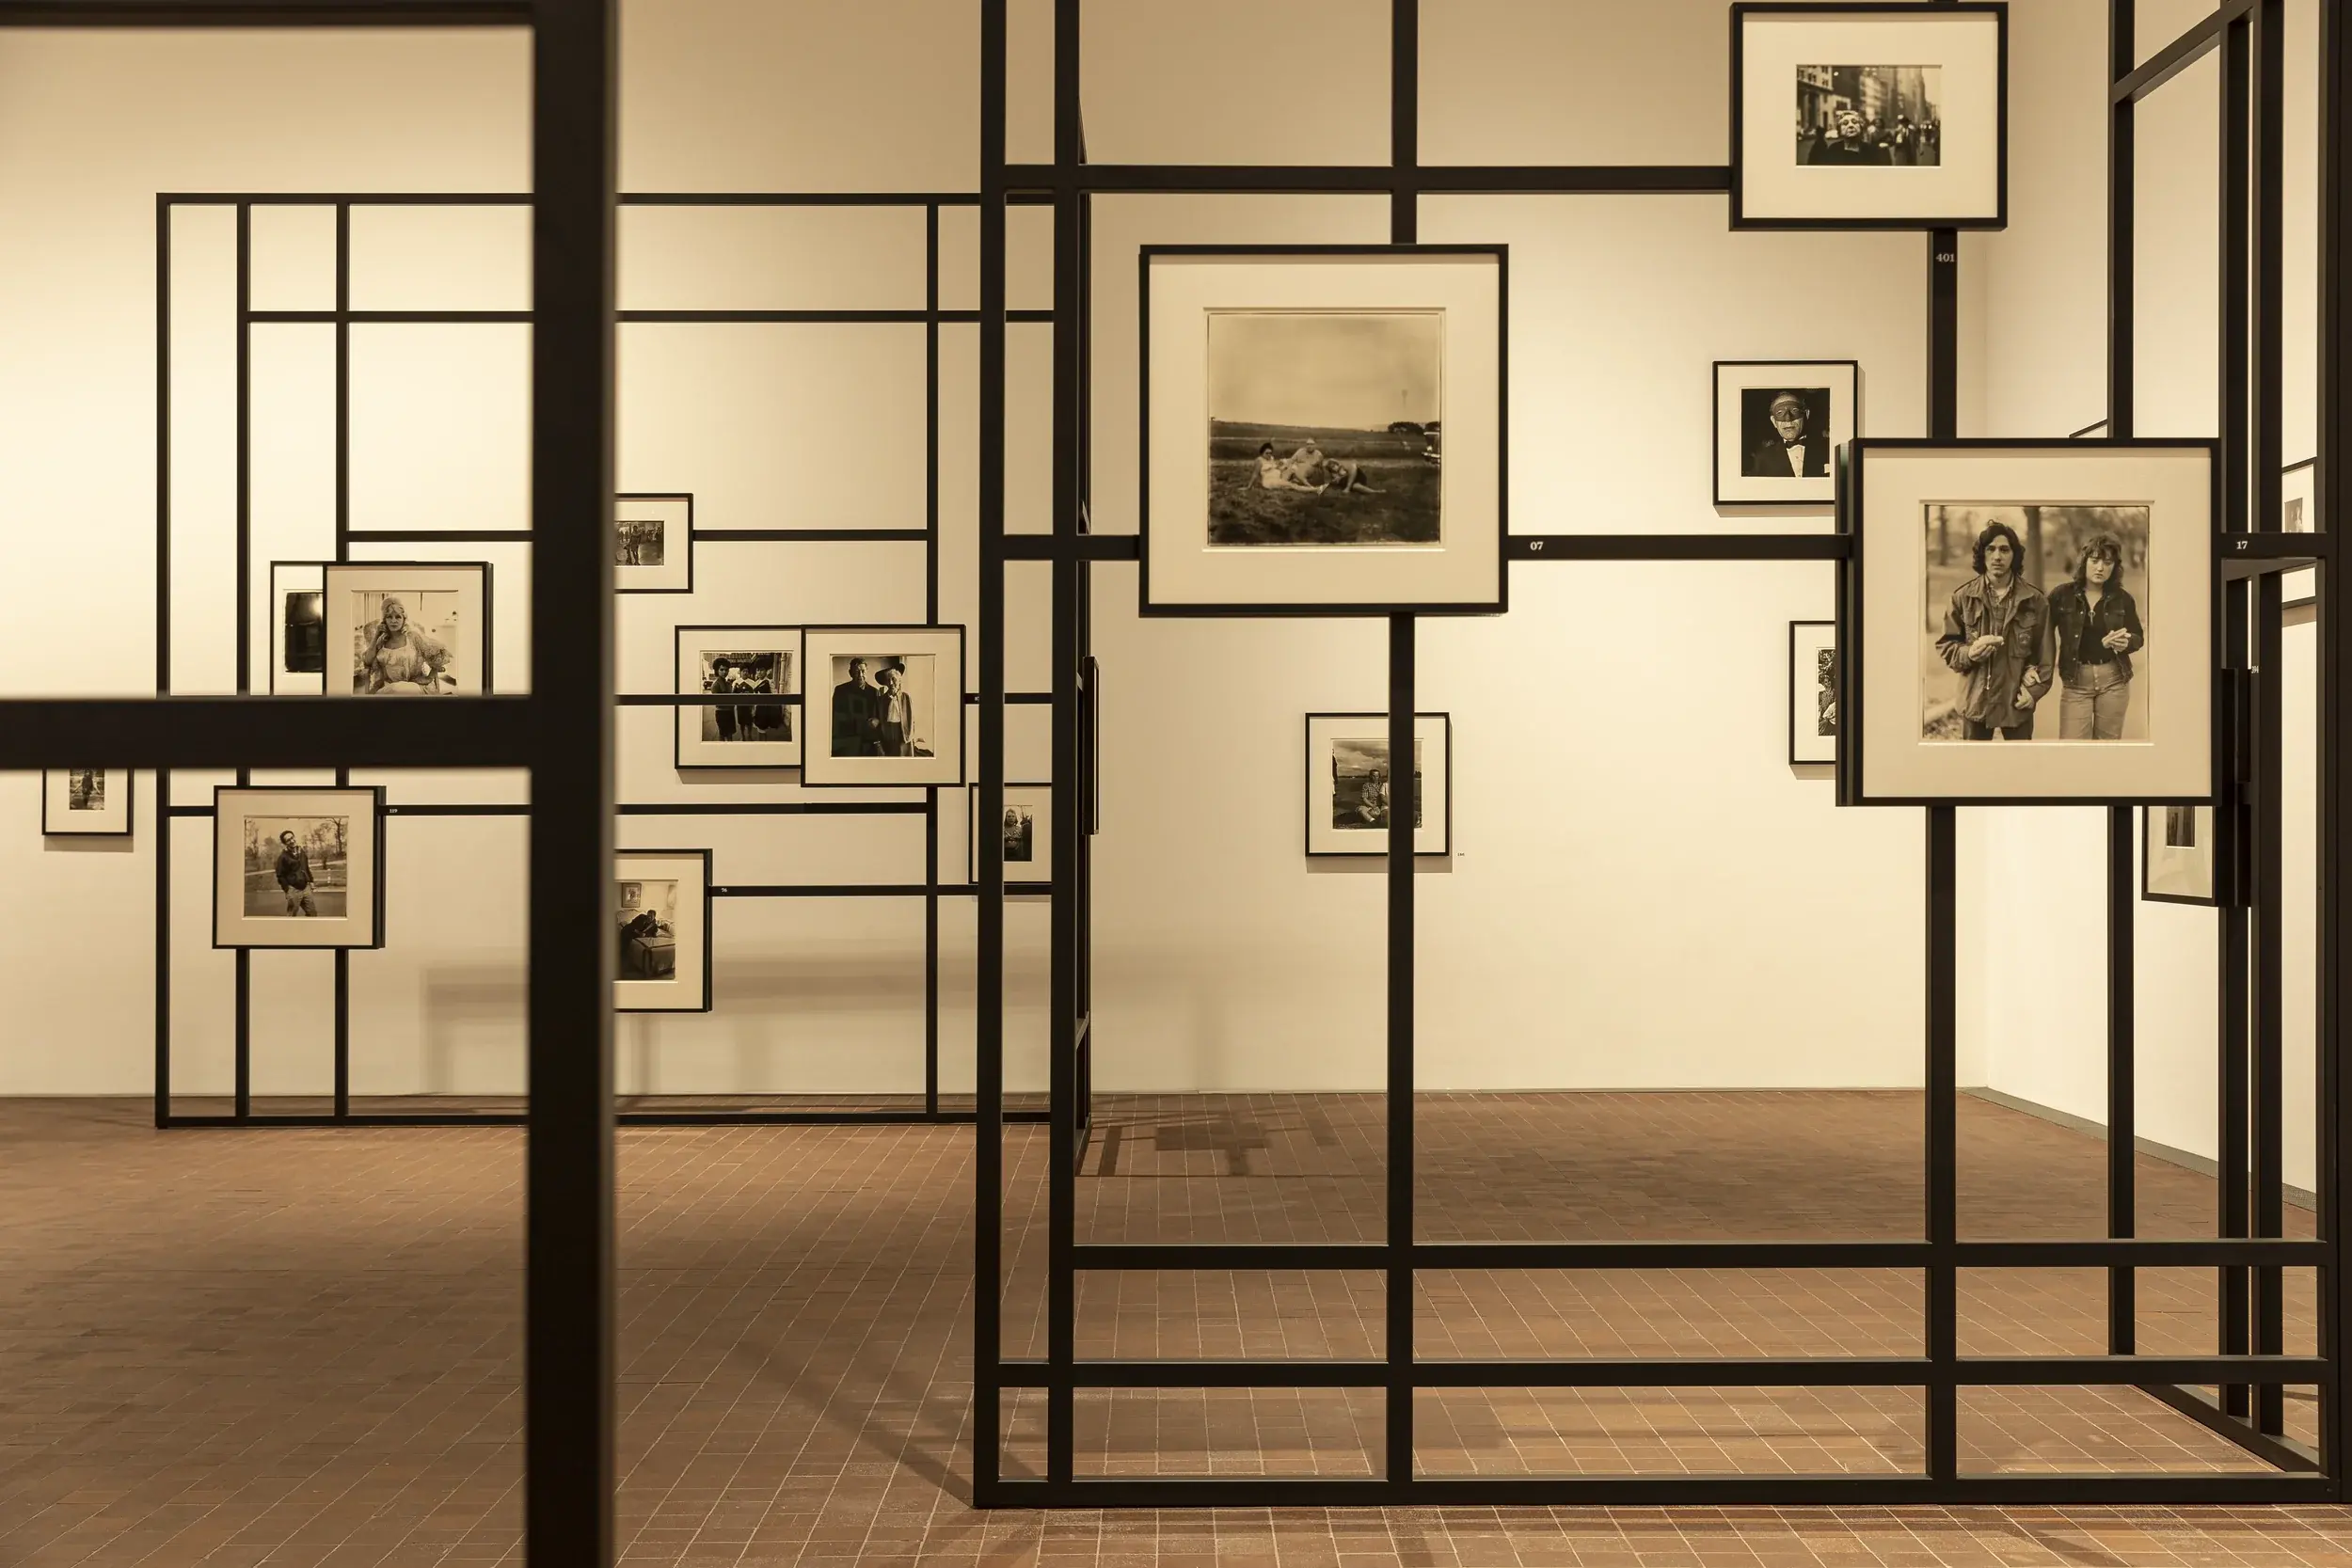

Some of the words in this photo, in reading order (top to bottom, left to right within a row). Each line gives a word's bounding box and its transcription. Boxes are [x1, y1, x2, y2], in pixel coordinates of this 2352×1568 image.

[1935, 253, 1955, 262] 401
[1530, 541, 1544, 551] 07
[2236, 540, 2249, 549] 17
